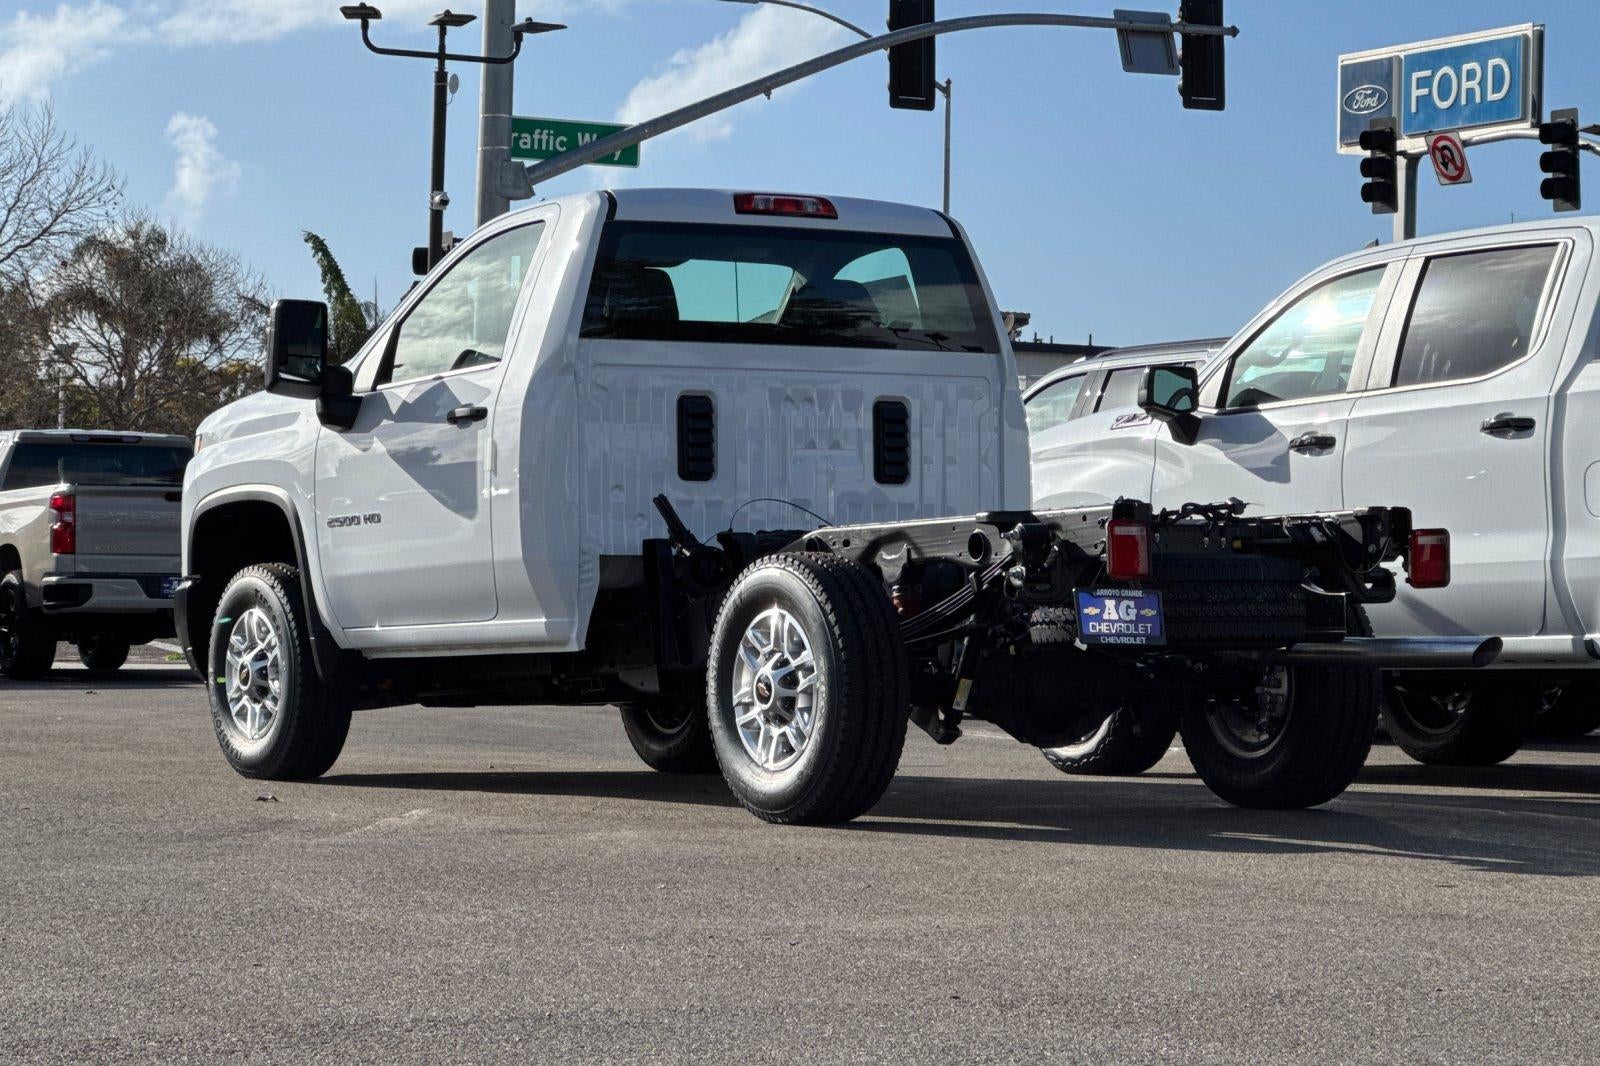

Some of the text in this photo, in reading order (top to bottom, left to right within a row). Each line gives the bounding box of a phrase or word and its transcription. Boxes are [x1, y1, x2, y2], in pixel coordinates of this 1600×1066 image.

[1410, 57, 1512, 113] FORD
[1352, 89, 1379, 109] Ford
[510, 129, 568, 152] raffic
[326, 515, 361, 528] 2500
[1096, 588, 1144, 598] ARROYO GRANDE
[1102, 599, 1138, 621] AG
[1089, 621, 1152, 634] CHEVROLET
[1100, 636, 1147, 644] CHEVROLET
